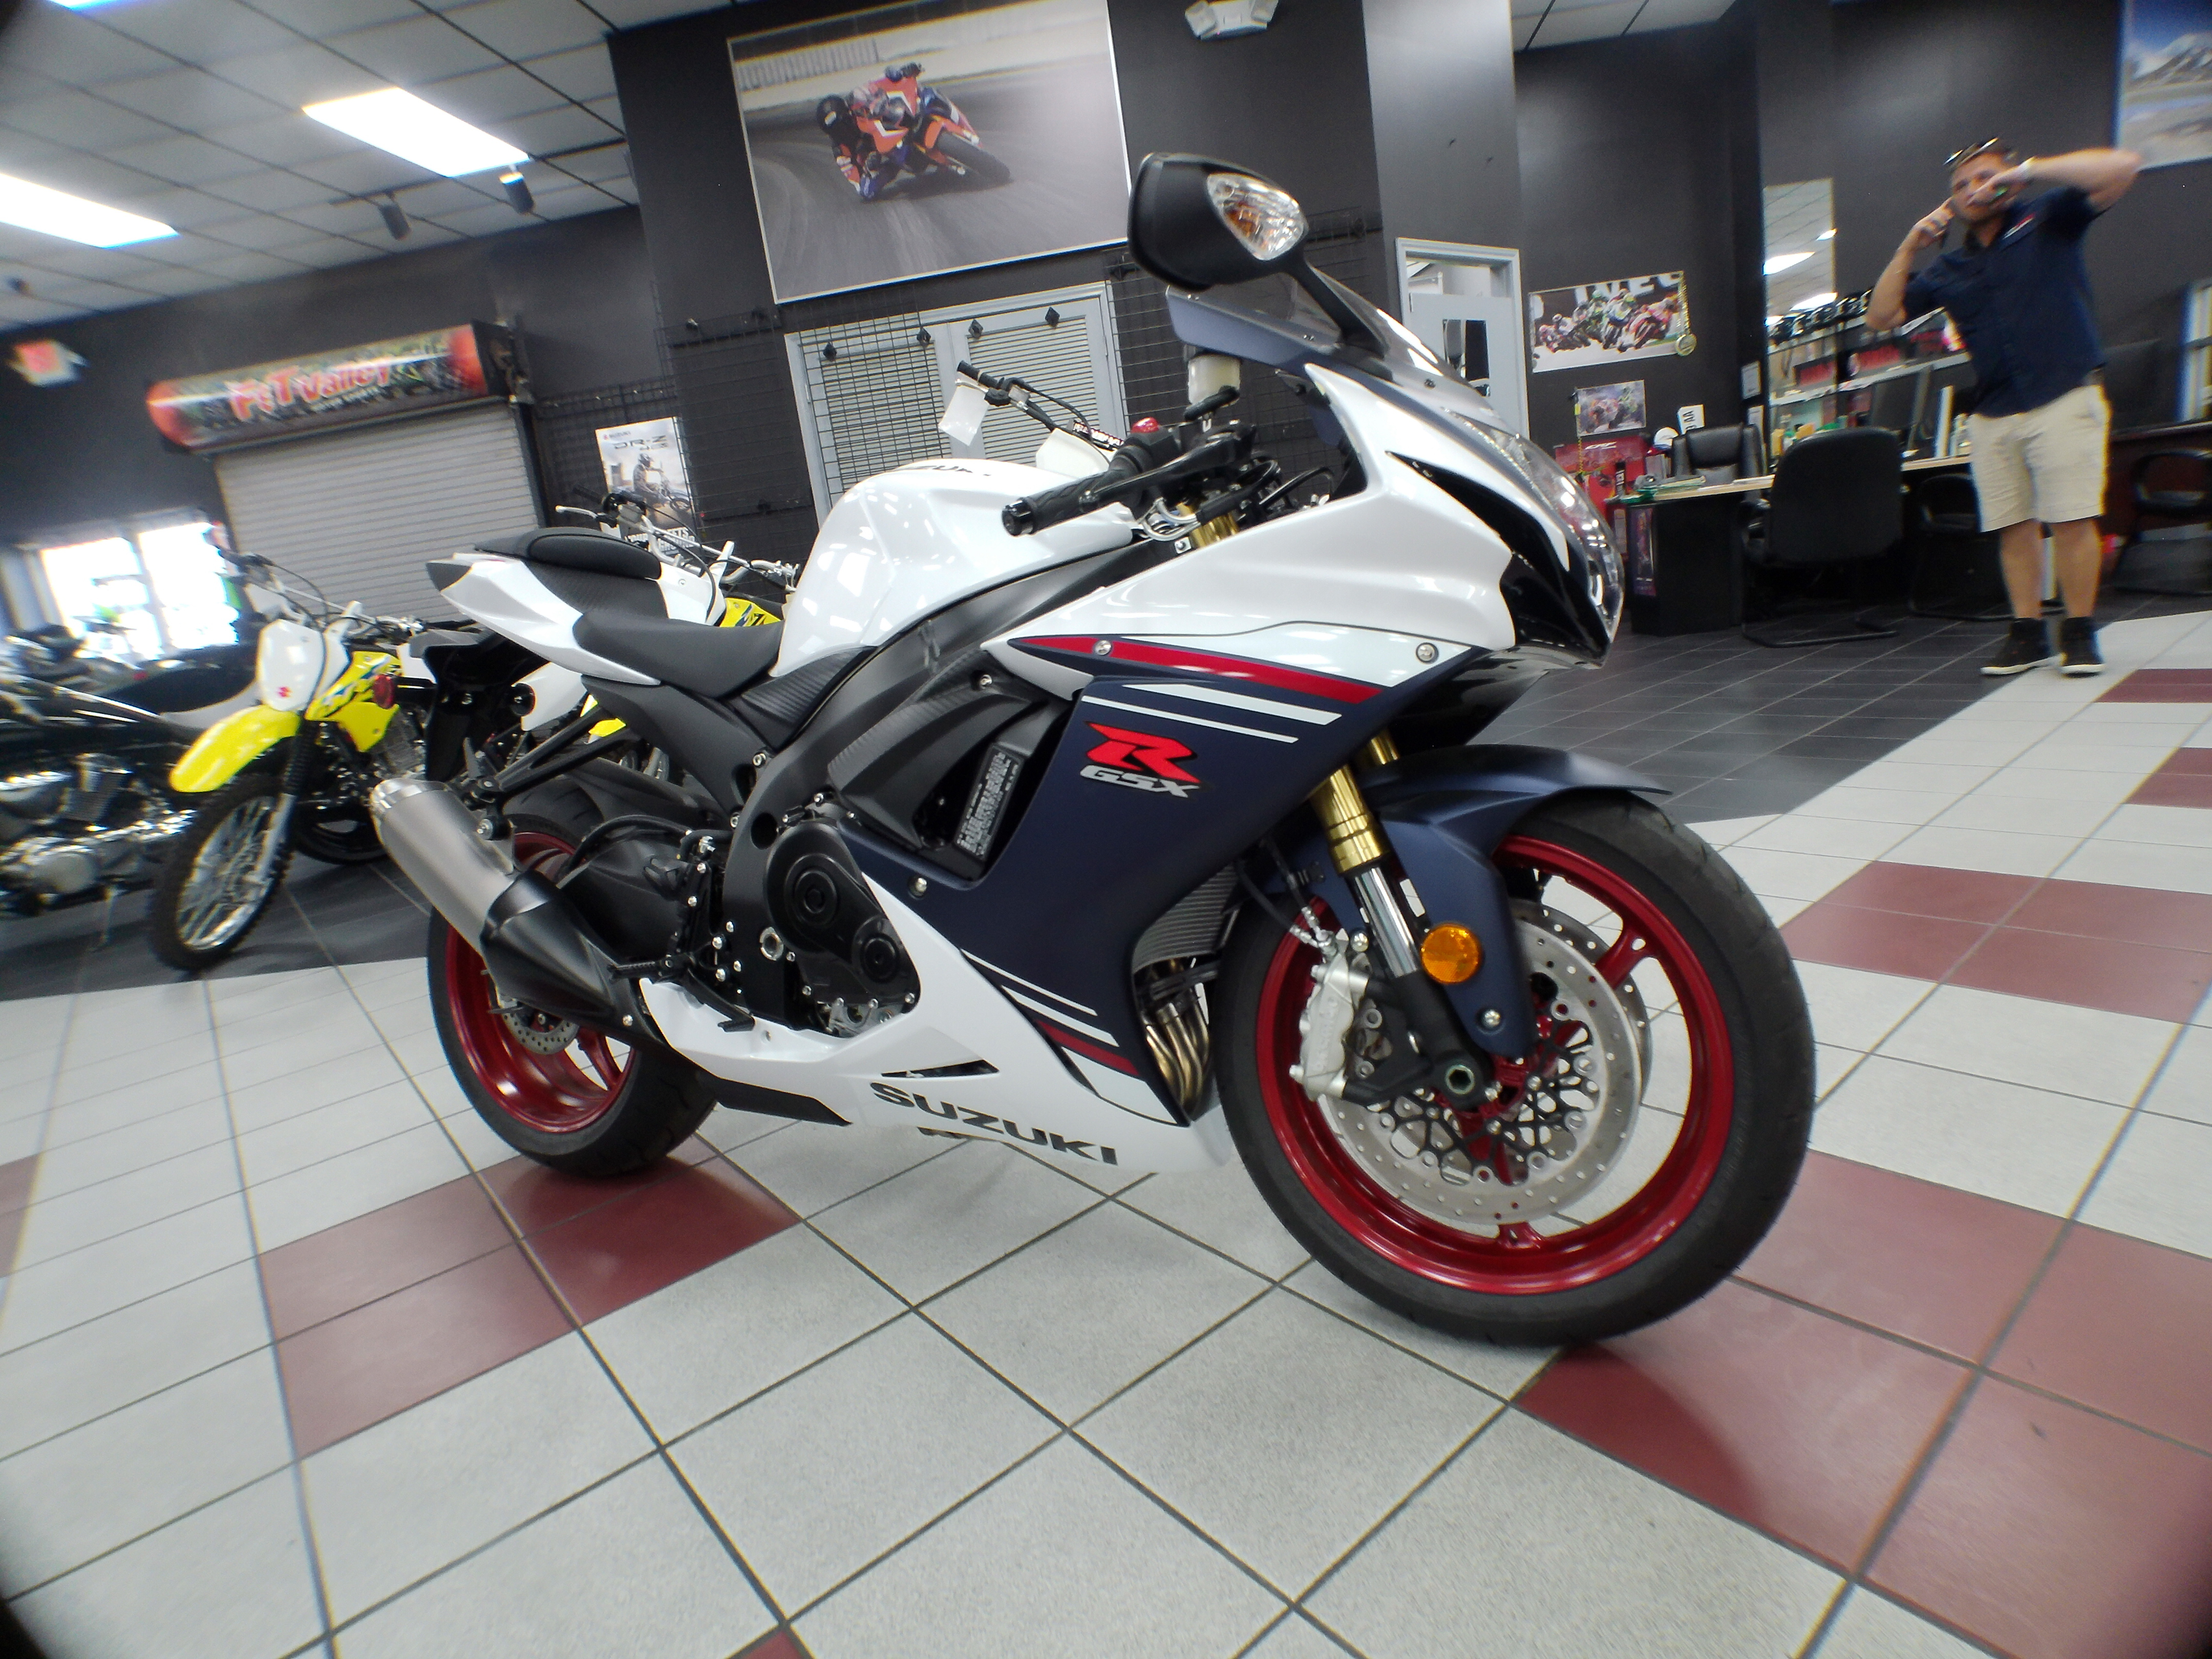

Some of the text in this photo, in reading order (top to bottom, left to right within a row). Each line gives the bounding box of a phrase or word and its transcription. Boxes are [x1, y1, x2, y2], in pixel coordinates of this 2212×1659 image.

[1079, 764, 1200, 798] GSX
[1087, 722, 1202, 783] R
[870, 1082, 1118, 1165] SUZUKI
